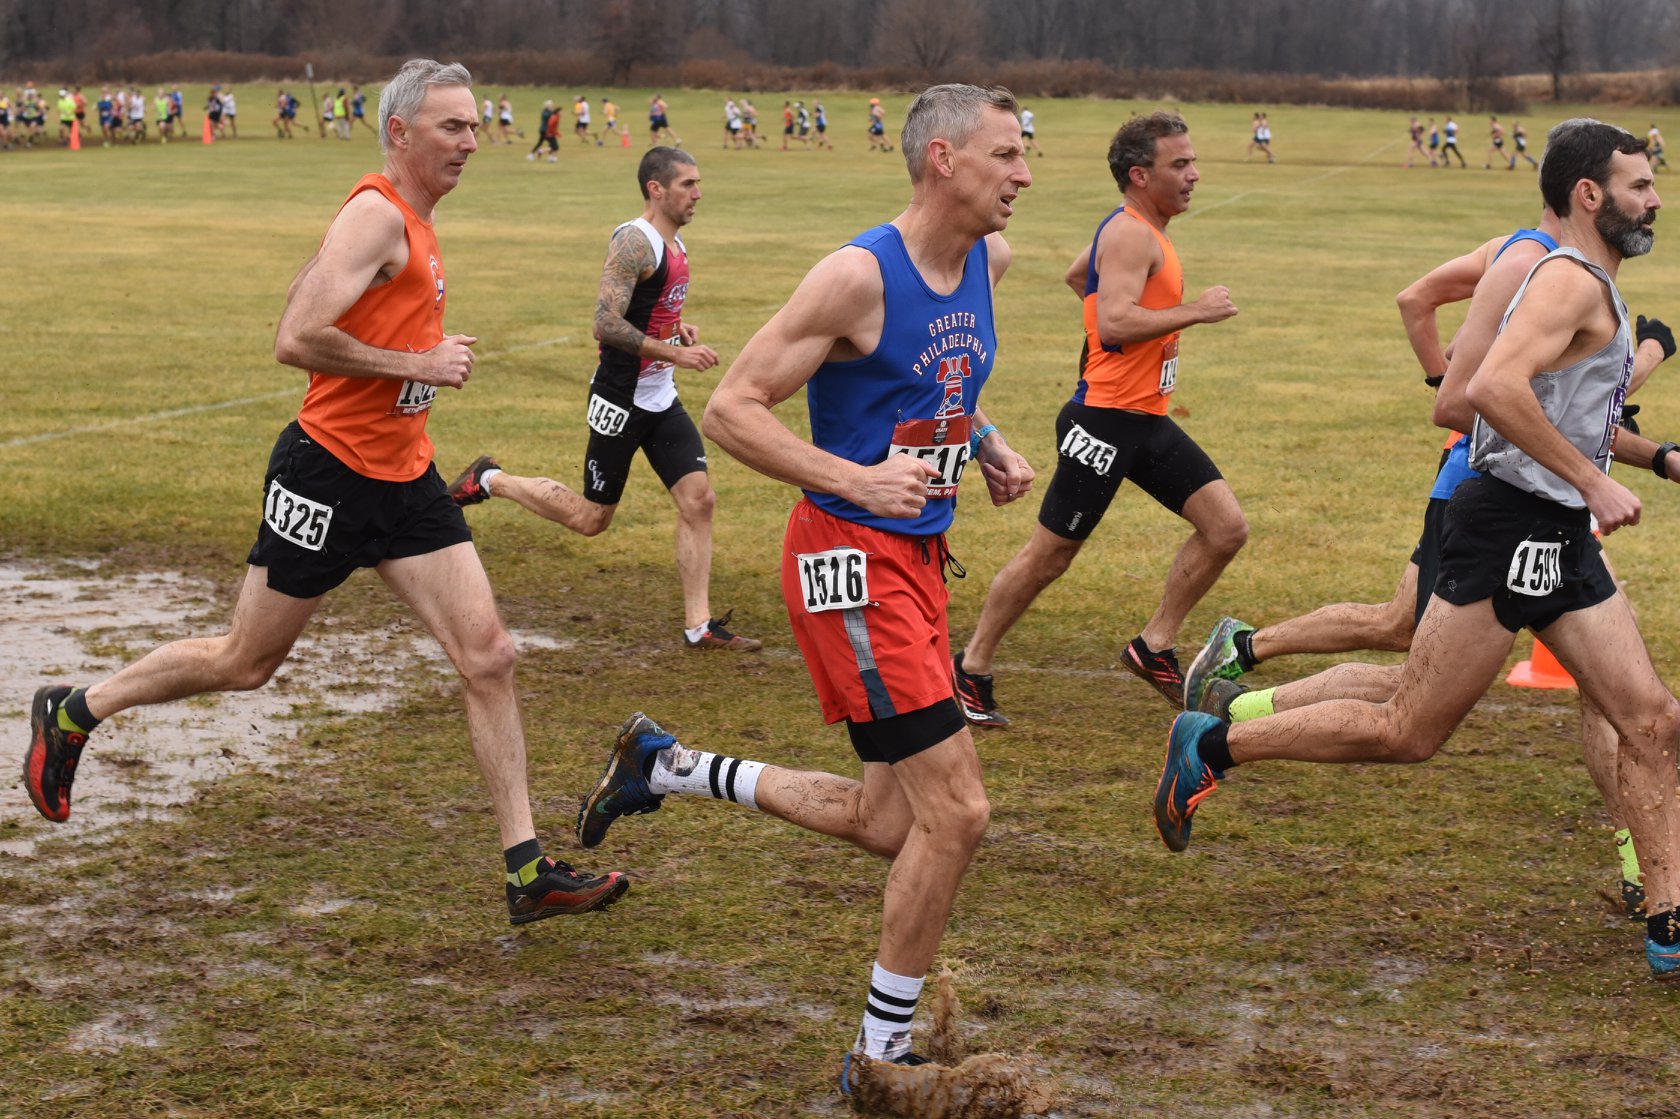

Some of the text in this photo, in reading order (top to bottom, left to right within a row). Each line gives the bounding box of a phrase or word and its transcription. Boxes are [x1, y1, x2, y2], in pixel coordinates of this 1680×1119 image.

[928, 312, 976, 337] GREATER
[912, 333, 987, 376] PHILADELPHIA
[589, 399, 625, 434] 1459
[1061, 430, 1114, 474] 1245
[269, 488, 329, 546] 1325
[804, 553, 863, 607] 1516
[1512, 546, 1559, 591] 1593
